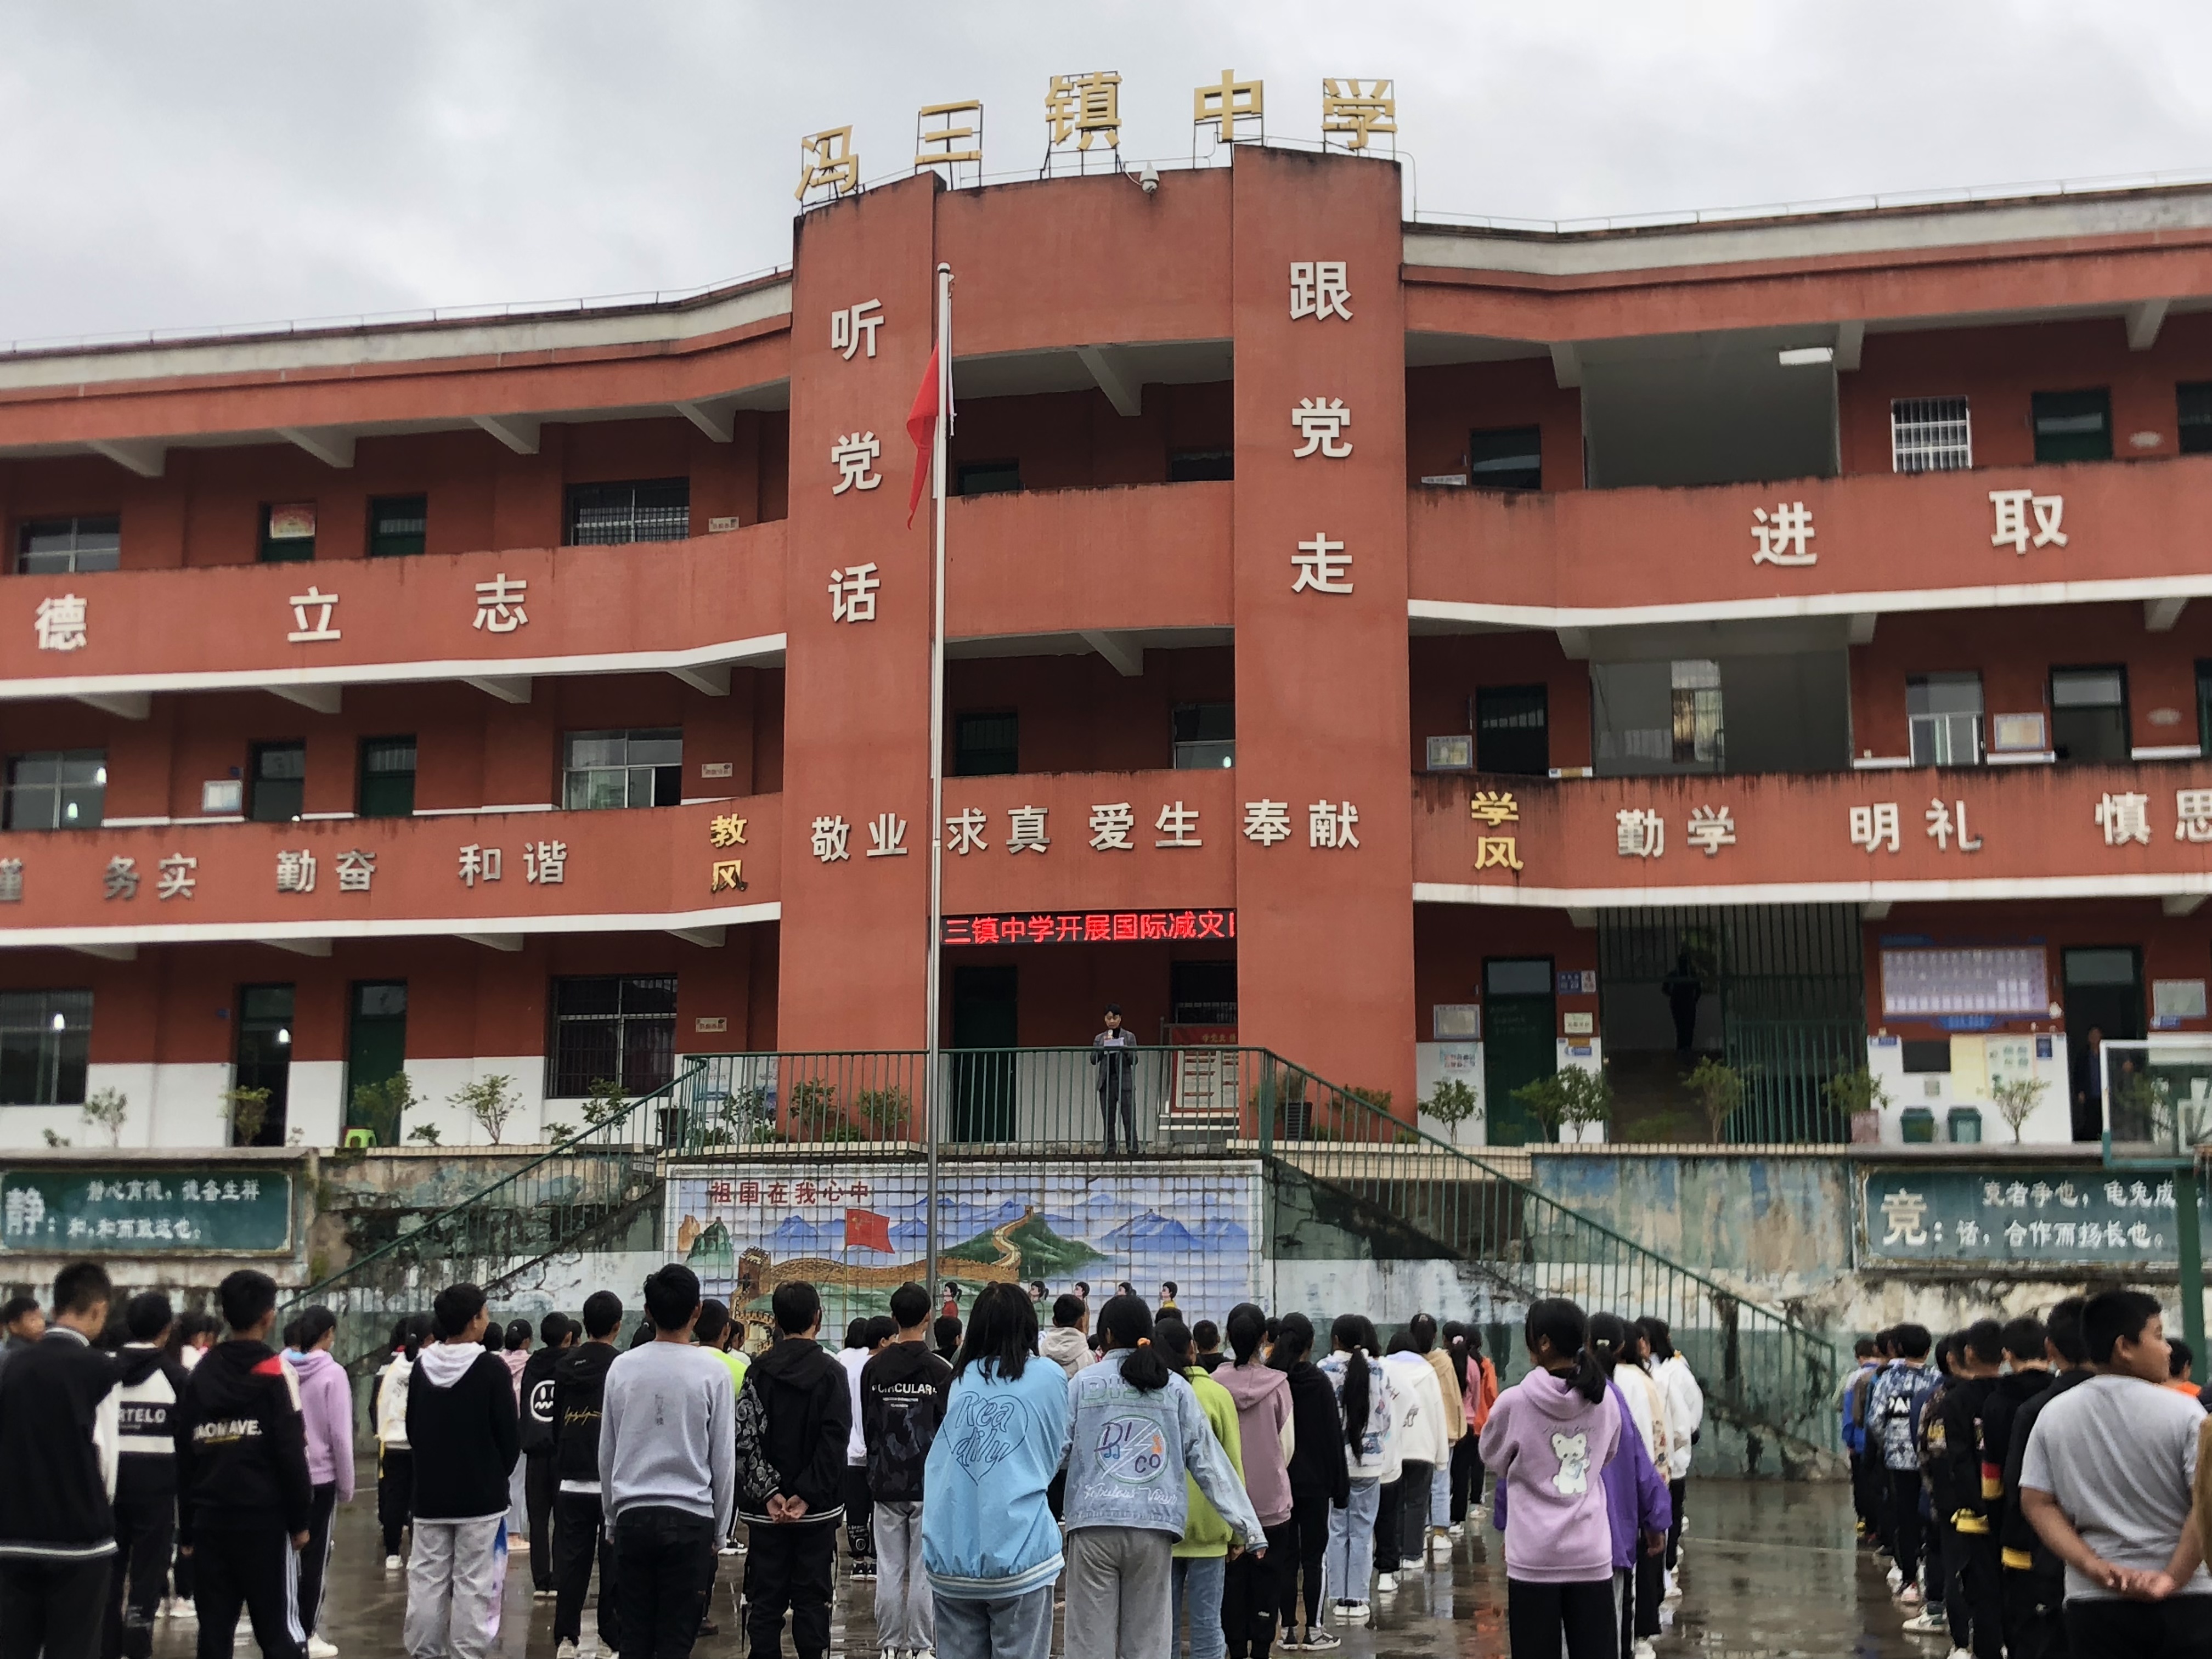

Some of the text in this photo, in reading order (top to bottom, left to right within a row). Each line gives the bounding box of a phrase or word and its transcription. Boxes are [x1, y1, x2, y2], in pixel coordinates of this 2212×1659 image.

[794, 69, 1397, 200] 冯三镇中学
[828, 298, 884, 623] 听党话
[1289, 261, 1354, 594] 跟党走
[1751, 489, 2068, 566] 进取
[710, 813, 748, 894] 教风
[811, 799, 1360, 862] 敬业 求真 爱生 奉献
[1471, 791, 1524, 871] 学风
[1616, 805, 1736, 857] 勤学
[1849, 798, 1983, 853] 明礼
[103, 853, 198, 901] 务实
[276, 848, 377, 893] 勤奋
[458, 840, 568, 887] 和谐
[940, 910, 1235, 945] 三镇中学开展国际减灾
[710, 1181, 869, 1205] 祖国在我心中
